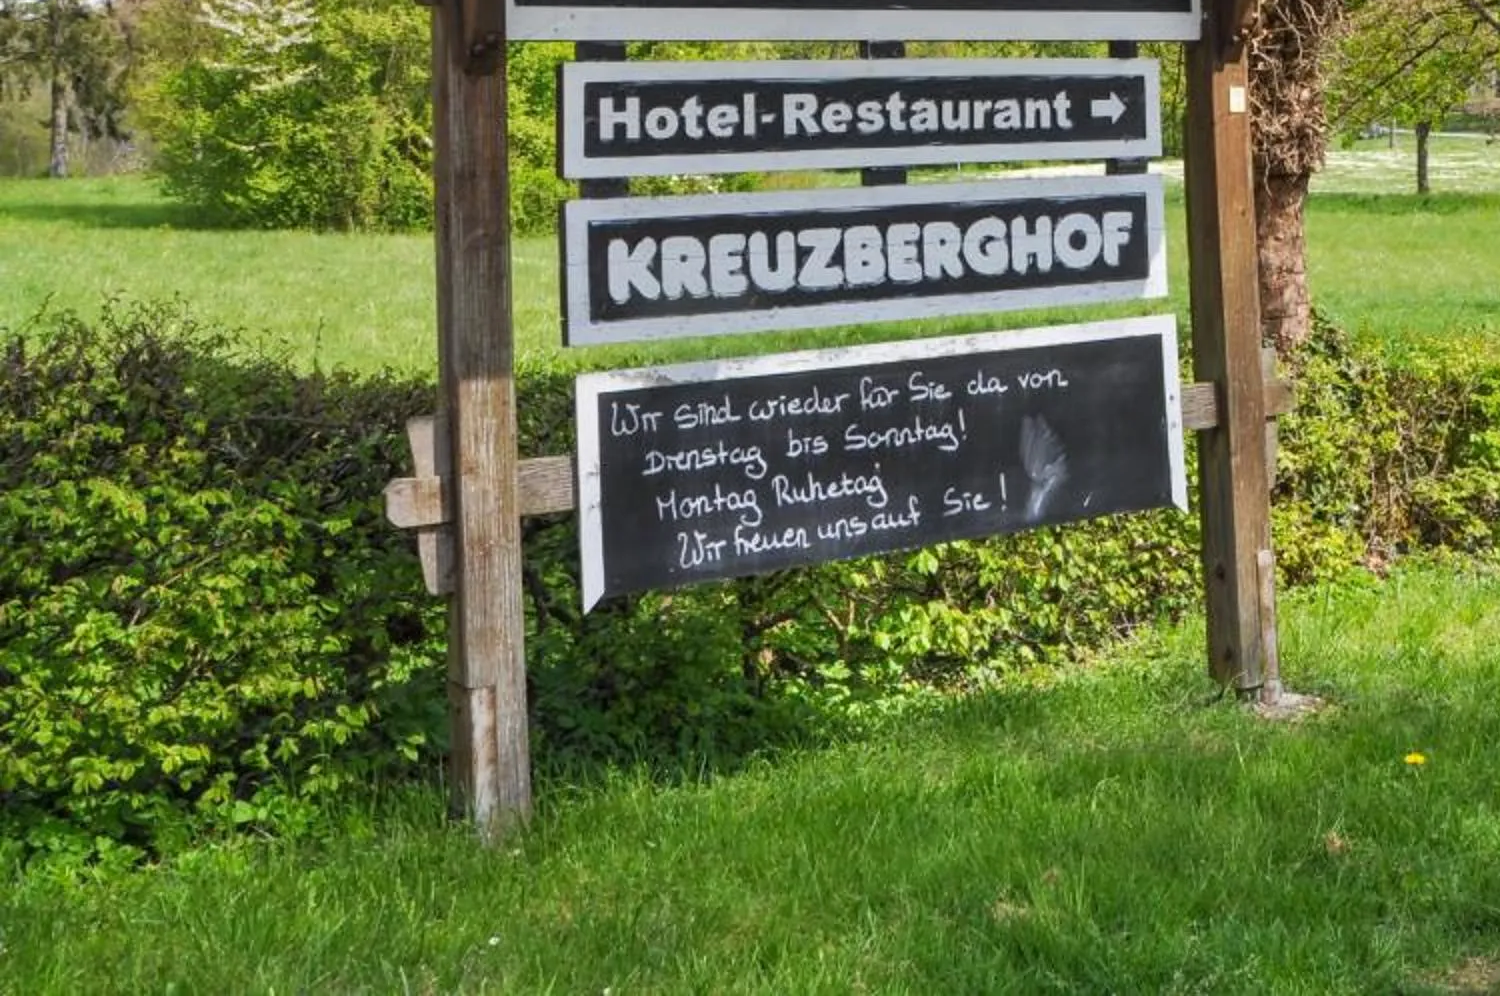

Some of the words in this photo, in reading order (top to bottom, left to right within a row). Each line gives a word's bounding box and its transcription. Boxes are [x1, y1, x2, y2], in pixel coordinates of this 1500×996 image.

[599, 91, 1072, 140] Hotel-Restaurant
[606, 211, 1133, 303] KREUZBERGHOF
[611, 401, 664, 436] Wir
[749, 385, 849, 421] wieder
[909, 371, 953, 402] Sie
[967, 369, 1008, 396] da
[1017, 368, 1069, 390] von
[641, 440, 768, 479] Dienstag
[786, 427, 829, 457] bis
[843, 408, 967, 451] Sonntag!
[656, 483, 763, 527] Montag
[771, 471, 889, 508] Ruhetag
[677, 529, 727, 569] Wir
[733, 524, 811, 556] freuen
[817, 515, 868, 541] uns
[871, 495, 921, 530] auf
